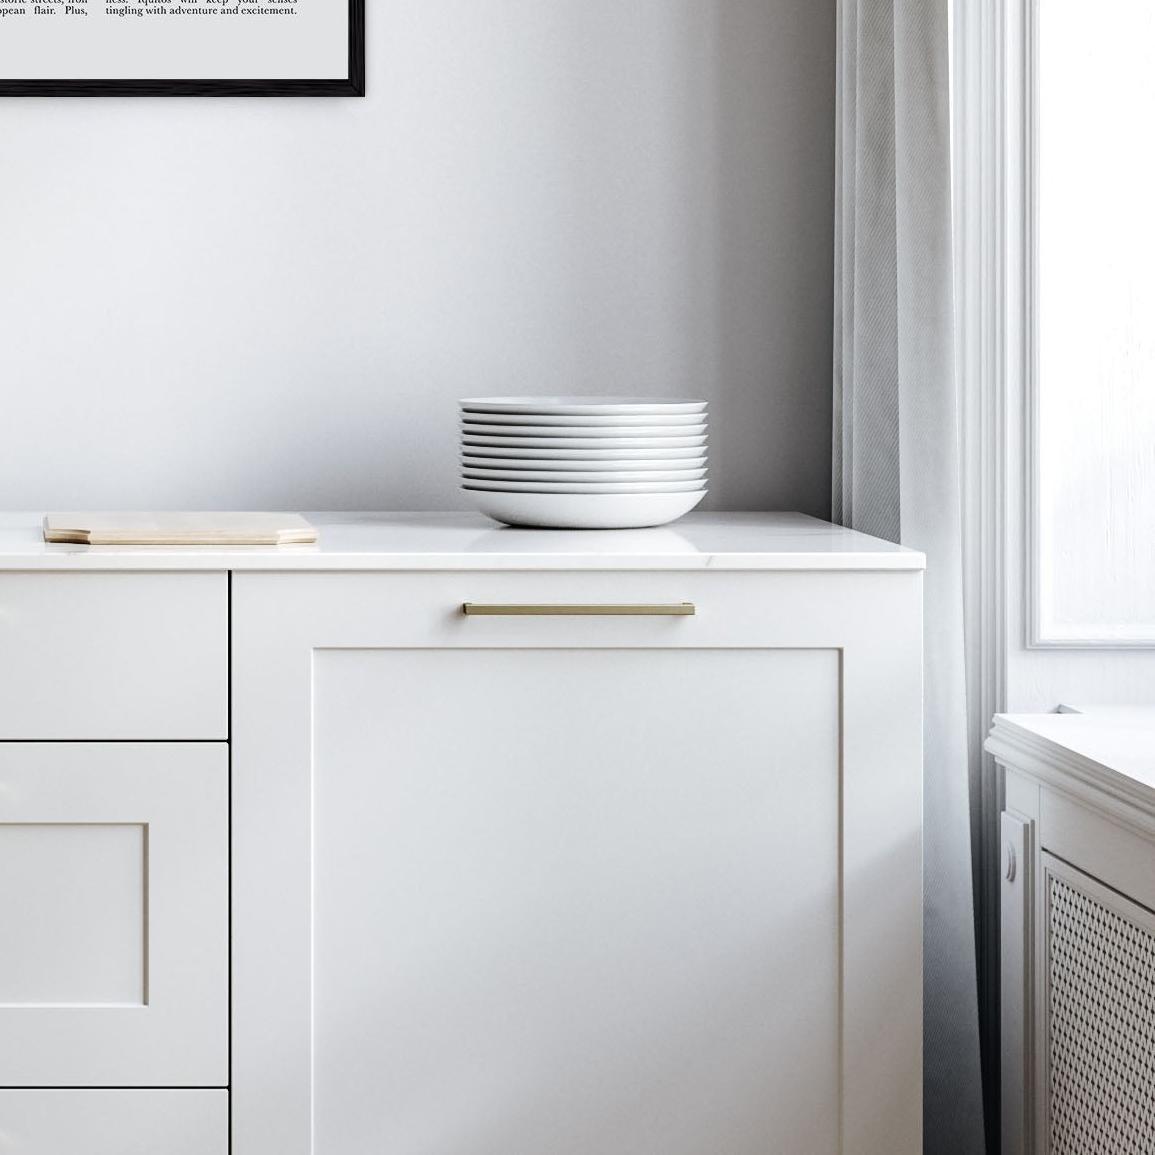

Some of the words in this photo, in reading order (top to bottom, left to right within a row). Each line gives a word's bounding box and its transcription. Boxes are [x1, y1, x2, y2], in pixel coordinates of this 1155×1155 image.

[34, 5, 56, 15] flair.
[65, 5, 88, 16] Plus,
[105, 5, 144, 17] tingling
[145, 5, 167, 15] with
[169, 6, 218, 15] adventure
[220, 5, 239, 15] and
[241, 5, 297, 15] excitement.
